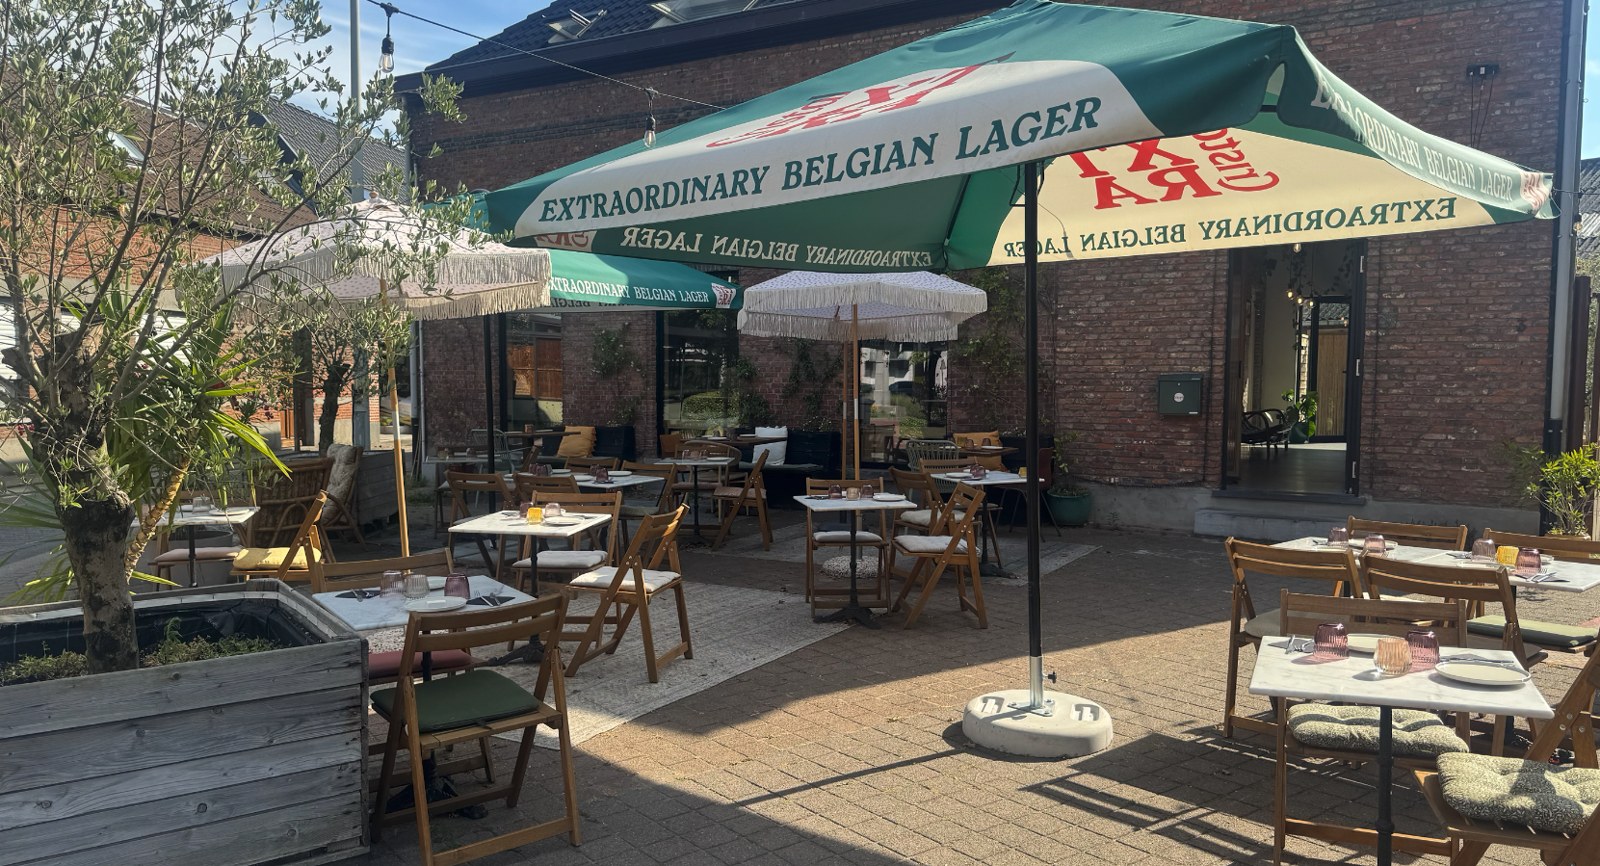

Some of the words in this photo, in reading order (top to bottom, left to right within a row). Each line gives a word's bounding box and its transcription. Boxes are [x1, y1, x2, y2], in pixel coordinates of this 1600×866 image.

[538, 165, 770, 222] EXTRAORDINARY
[782, 133, 939, 190] BELGIAN
[955, 97, 1102, 160] LAGER
[1423, 146, 1476, 190] BELGIAN
[1478, 166, 1514, 201] LAGER
[633, 286, 678, 302] BELGIAN
[680, 290, 710, 303] LAGER
